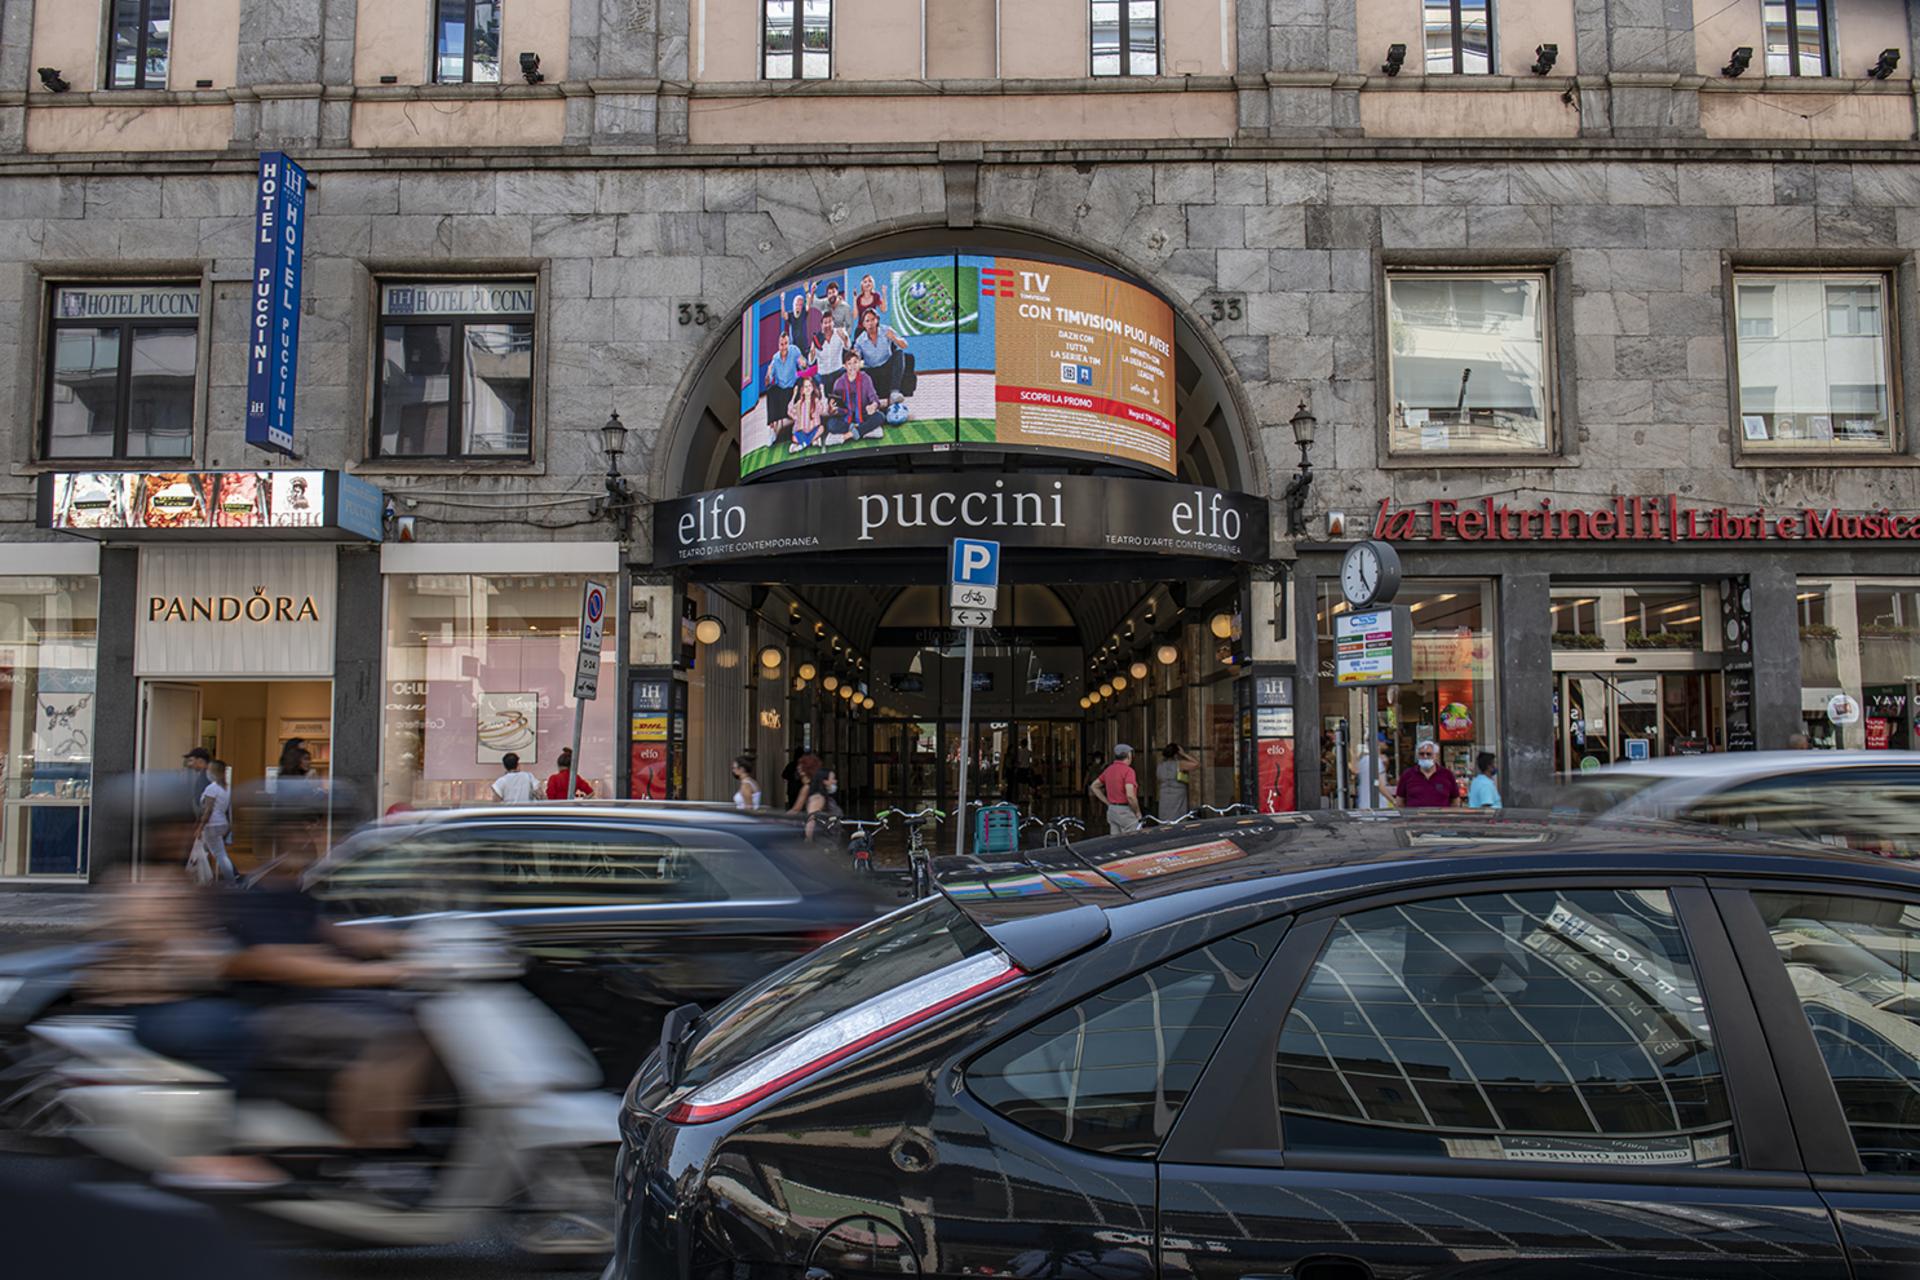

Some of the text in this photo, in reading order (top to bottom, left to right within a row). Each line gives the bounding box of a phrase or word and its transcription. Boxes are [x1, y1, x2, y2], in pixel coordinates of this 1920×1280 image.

[284, 203, 298, 310] HOTEL
[254, 163, 277, 374] HOTEL PUCCINI
[1019, 271, 1050, 293] TV
[88, 294, 137, 315] HOTEL
[140, 292, 200, 315] PUCCINI
[416, 289, 533, 312] HOTEL PUCCINI
[1210, 299, 1242, 321] 33
[678, 303, 708, 325] 33
[1018, 304, 1170, 357] CON TIMVISION PUOI AVERE
[1050, 350, 1060, 359] LA
[1066, 343, 1088, 353] TUTTA
[278, 317, 290, 427] PUCCINI
[1020, 390, 1093, 408] SCOPRI LA PROMO
[678, 493, 746, 545] elfo
[857, 479, 1066, 540] puccini
[1172, 491, 1241, 541] elfo
[1373, 496, 1416, 540] la
[1427, 496, 1663, 541] Feltrinelli
[1685, 507, 1767, 540] Libri
[1775, 515, 1797, 540] e
[679, 536, 819, 559] TEATRO D'ARTE CONTEMPORANEA
[1105, 534, 1241, 555] TEATRO D'ARTE CONTEMPORANEA
[962, 544, 991, 580] P
[148, 594, 320, 622] PANDORA
[640, 748, 659, 760] elfo
[1266, 744, 1285, 756] elfo
